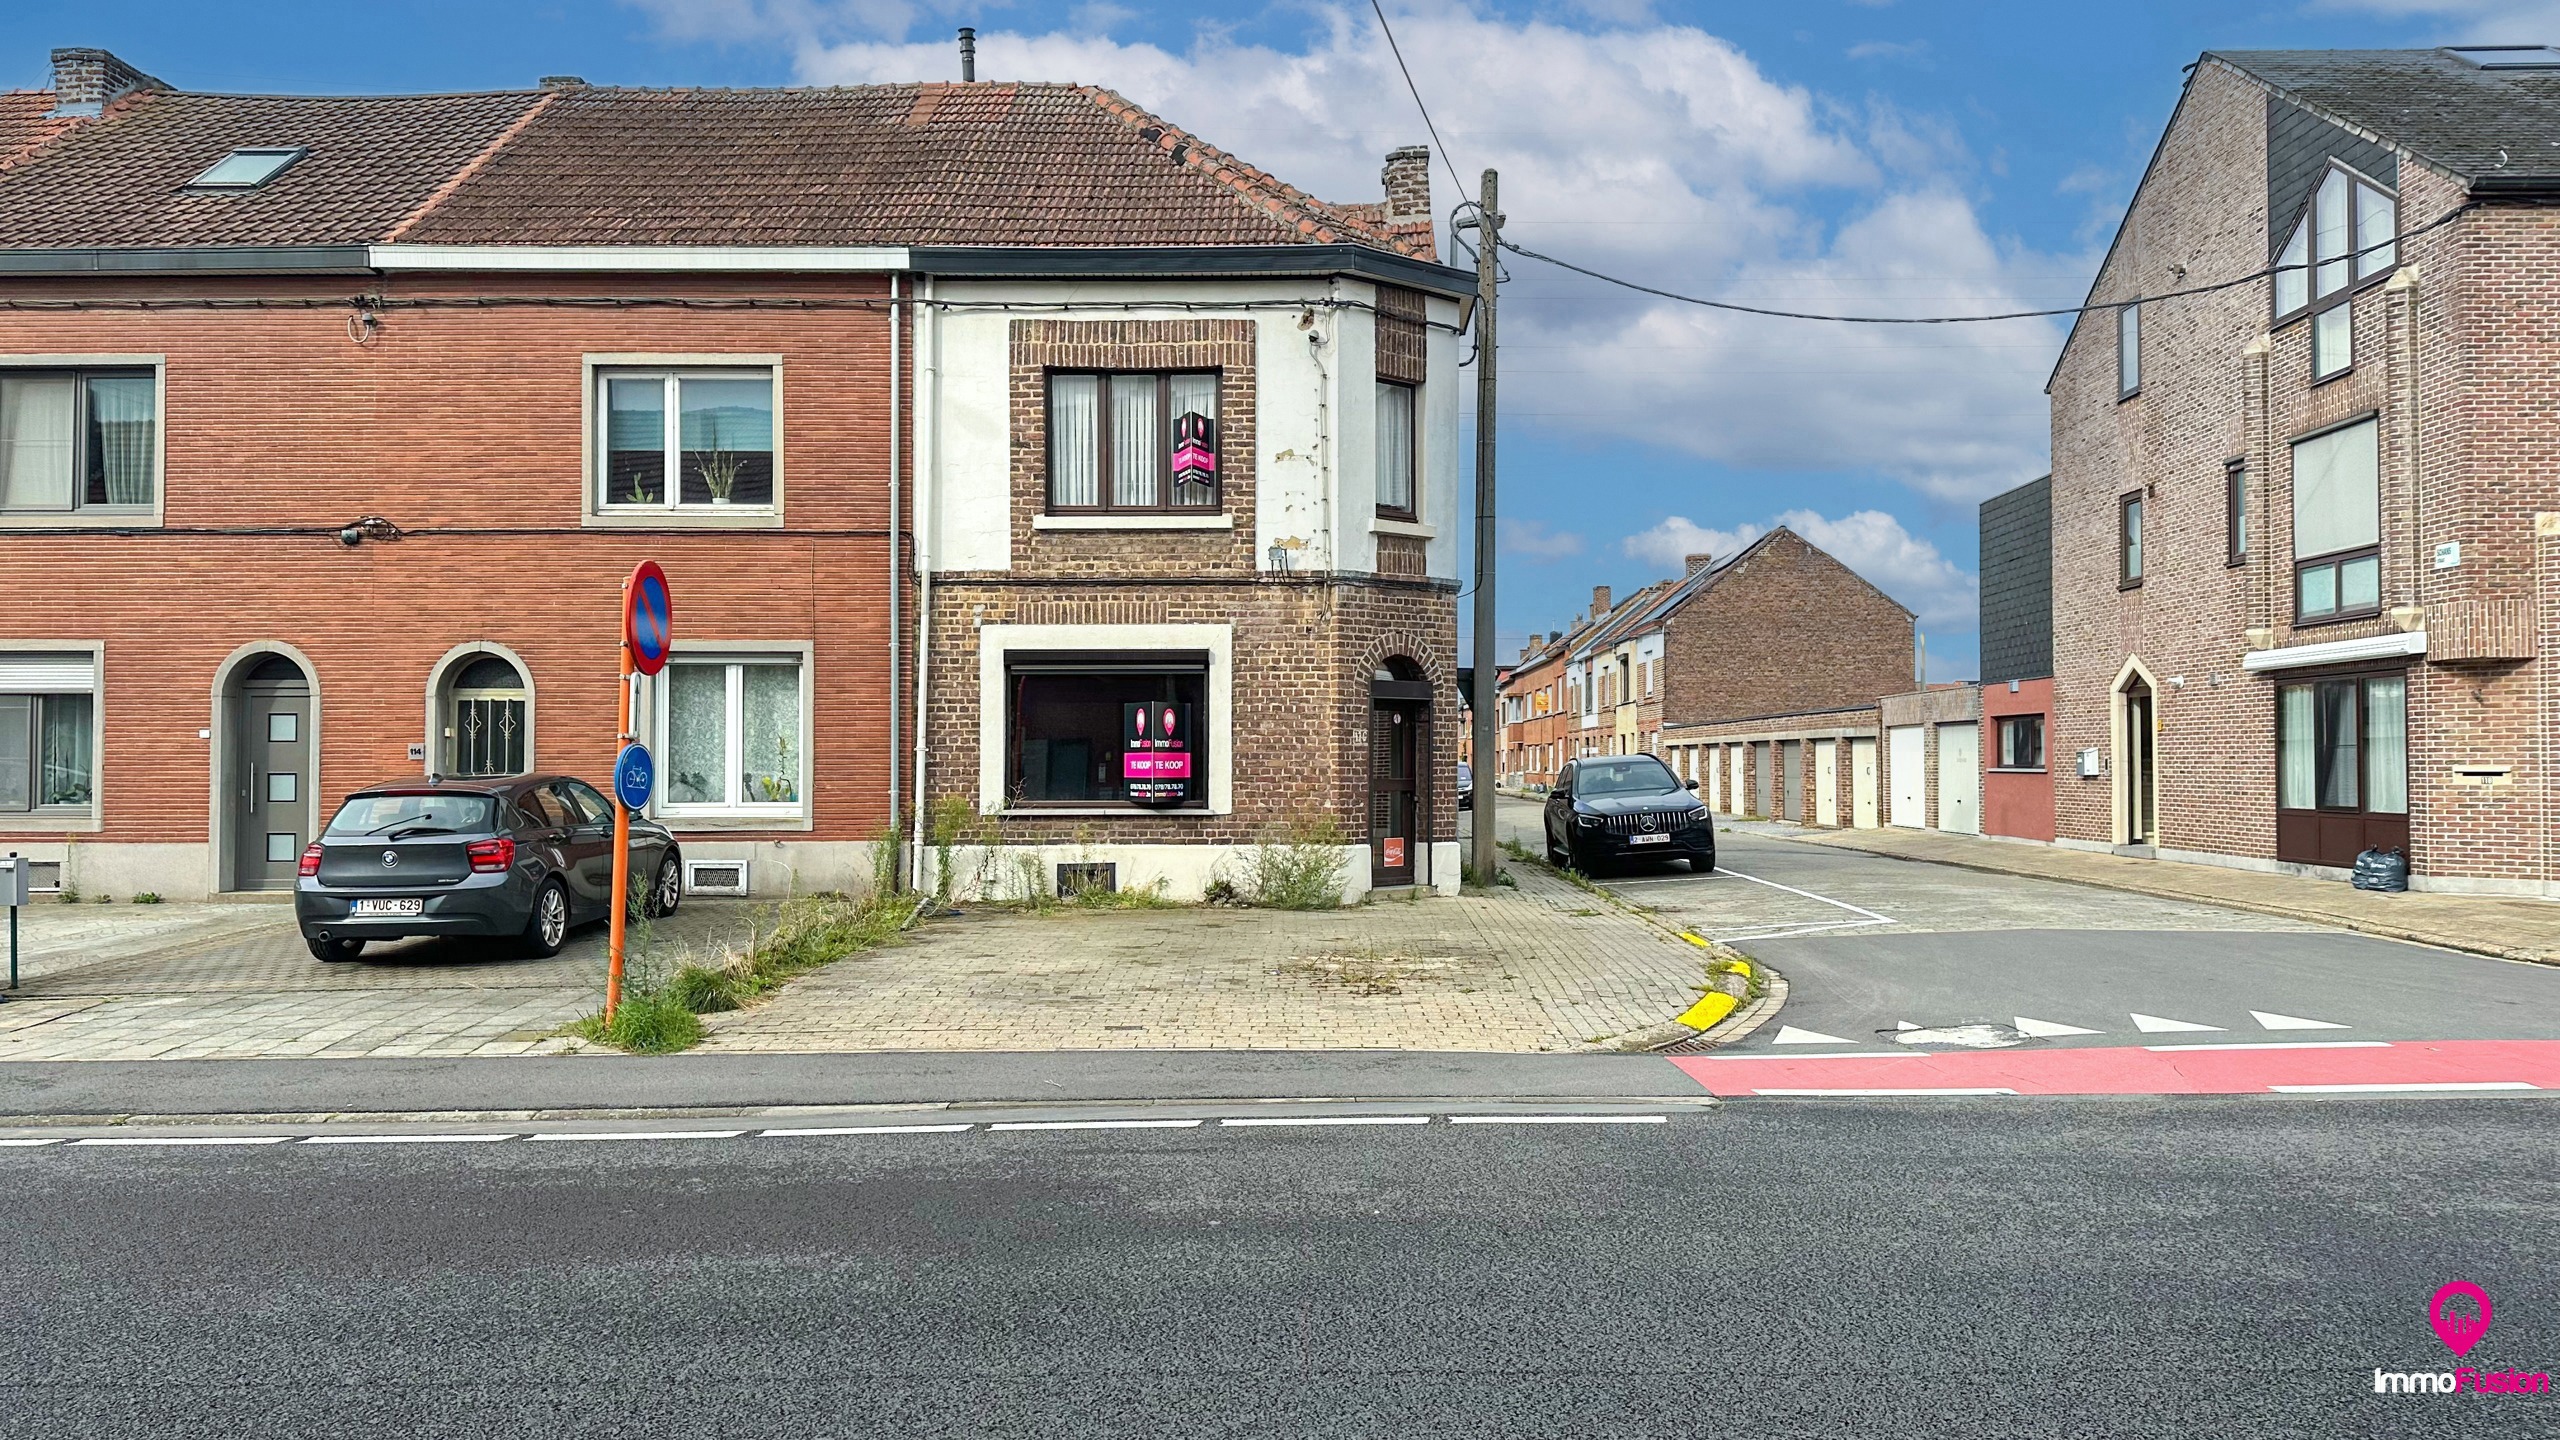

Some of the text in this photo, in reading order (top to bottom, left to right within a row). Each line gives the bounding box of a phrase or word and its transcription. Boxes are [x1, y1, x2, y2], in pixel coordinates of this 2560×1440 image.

[1154, 760, 1184, 769] TE KOOP
[359, 900, 421, 911] 1-VUC-629
